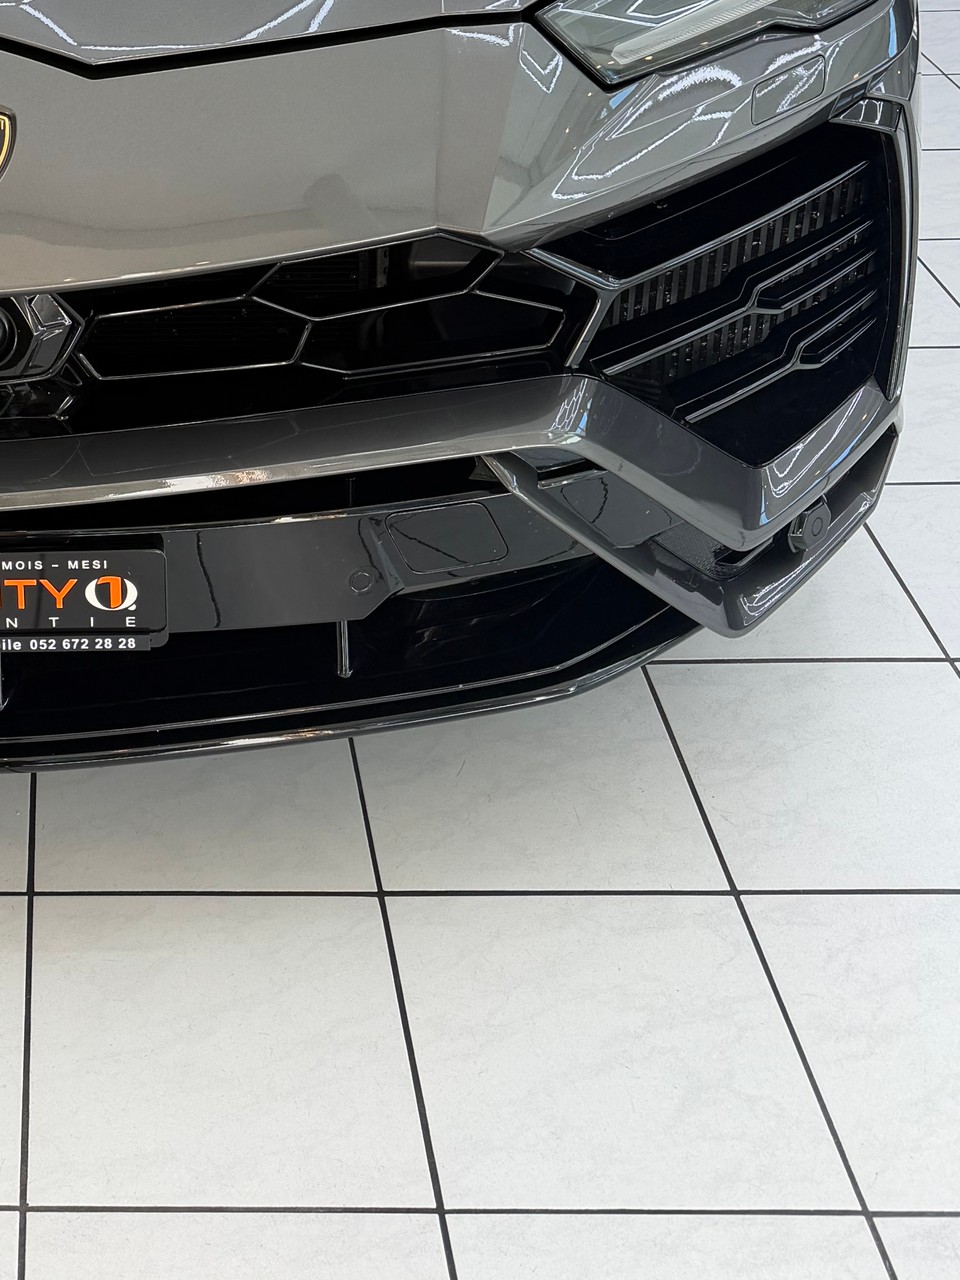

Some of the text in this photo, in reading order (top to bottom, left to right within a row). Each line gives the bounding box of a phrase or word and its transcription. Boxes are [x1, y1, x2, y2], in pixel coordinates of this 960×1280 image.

[1, 560, 43, 570] MOIS
[67, 560, 108, 570] MESI
[29, 639, 57, 651] 052
[62, 639, 89, 650] 672
[95, 638, 113, 650] 28
[118, 638, 137, 650] 28
